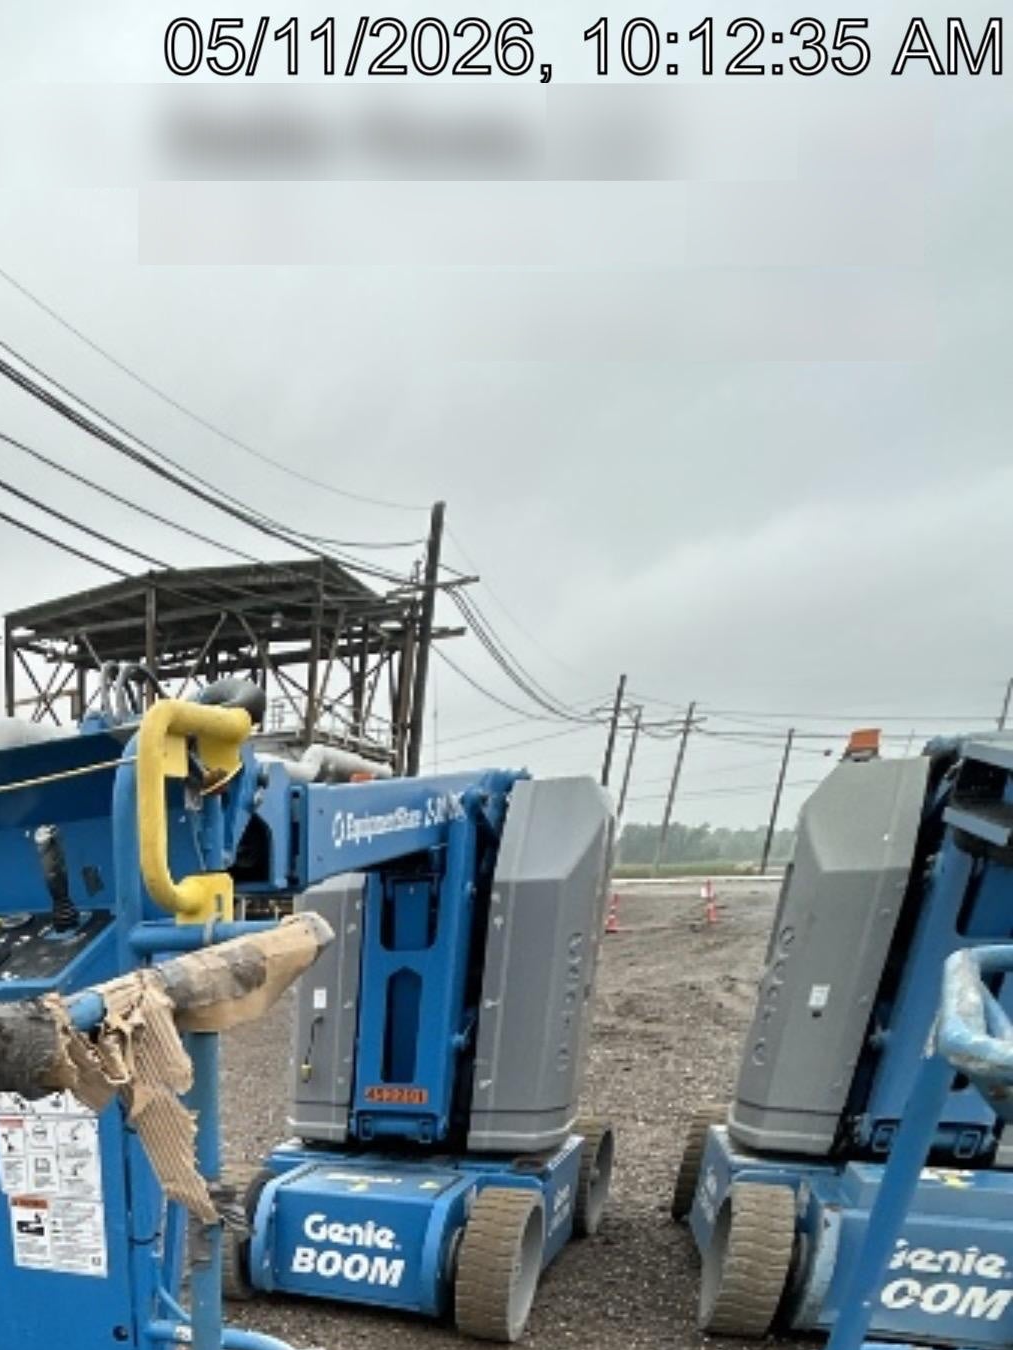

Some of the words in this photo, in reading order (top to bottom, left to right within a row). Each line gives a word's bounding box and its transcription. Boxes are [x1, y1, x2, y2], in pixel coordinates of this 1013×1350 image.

[304, 1213, 396, 1249] Genie
[291, 1246, 405, 1288] BOOM
[880, 1277, 1013, 1321] OOM
